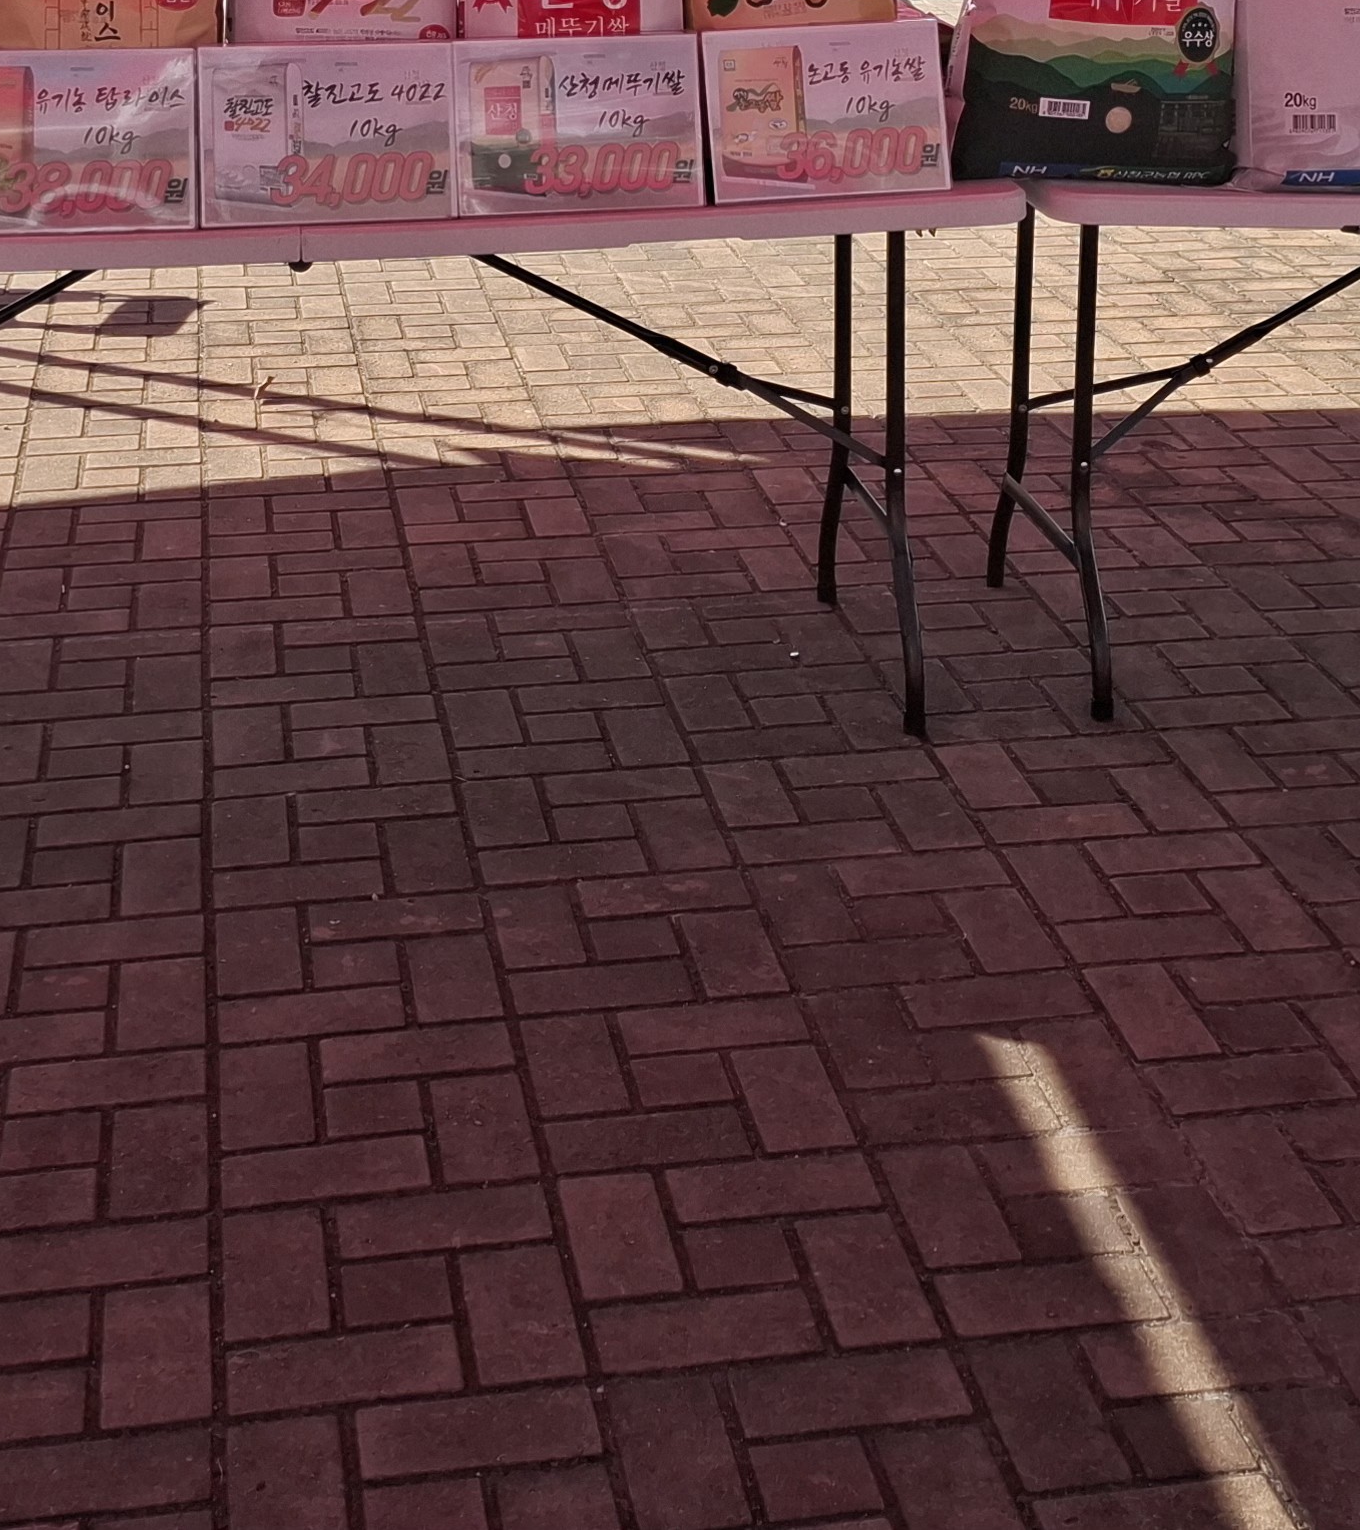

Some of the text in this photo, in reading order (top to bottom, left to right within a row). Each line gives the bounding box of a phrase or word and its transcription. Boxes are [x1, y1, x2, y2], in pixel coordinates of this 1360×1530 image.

[1181, 31, 1215, 49] 우수상
[558, 69, 685, 100] 산청메뚜기쌀
[807, 59, 852, 87] 논고동
[859, 55, 927, 86] 유기농쌀
[35, 85, 186, 114] 유기농 탑라이스
[301, 79, 447, 109] 찰진고도 4022
[1009, 96, 1038, 115] 20kg
[1284, 91, 1318, 110] 20kg
[598, 109, 651, 138] 10kg
[845, 95, 896, 123] 10kg
[82, 125, 139, 155] 10kg
[348, 117, 403, 147] 10kg
[1298, 171, 1336, 183] NH
